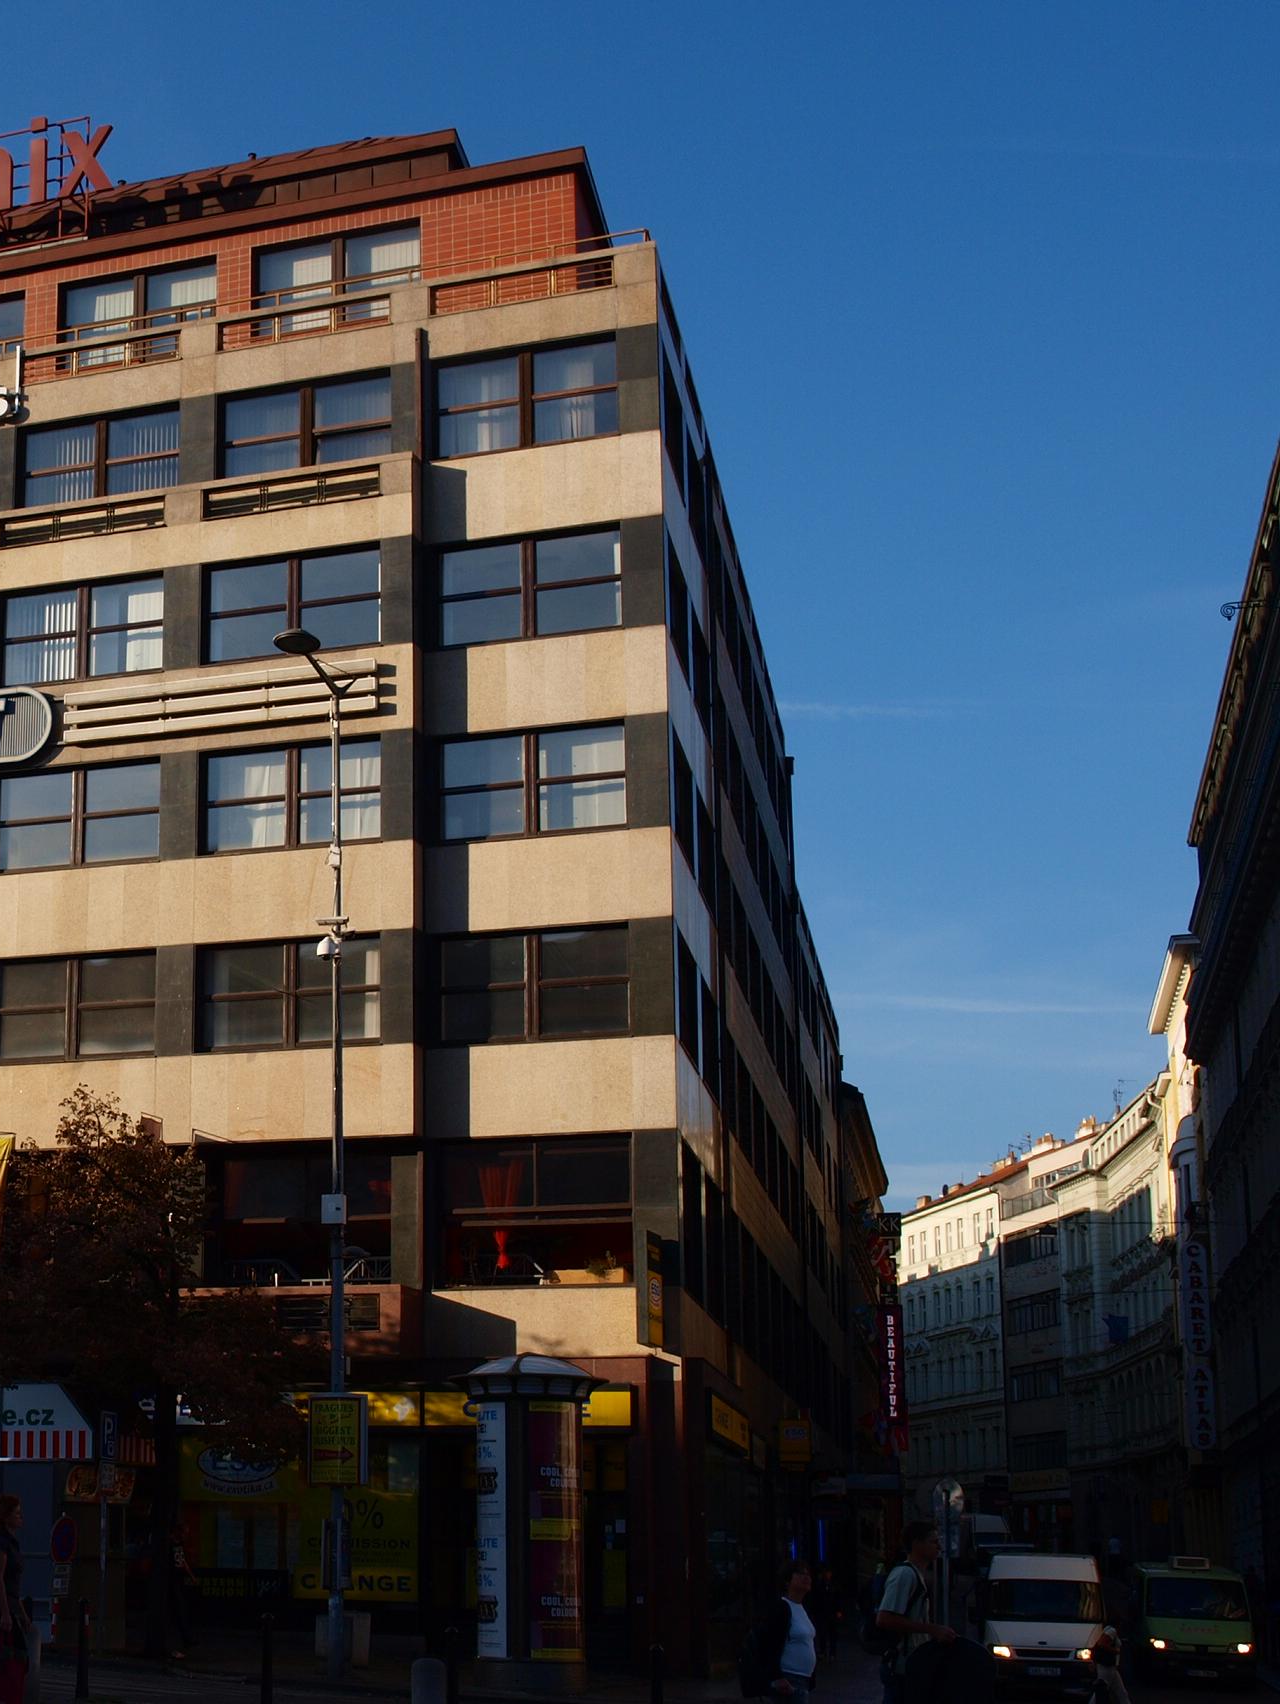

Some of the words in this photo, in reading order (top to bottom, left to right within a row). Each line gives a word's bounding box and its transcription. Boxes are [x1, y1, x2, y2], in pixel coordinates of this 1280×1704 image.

[1186, 1244, 1207, 1352] CABARET
[885, 1314, 898, 1418] BEAUTIFUL
[1192, 1368, 1212, 1446] ATLAS
[301, 1572, 412, 1593] CNGE
